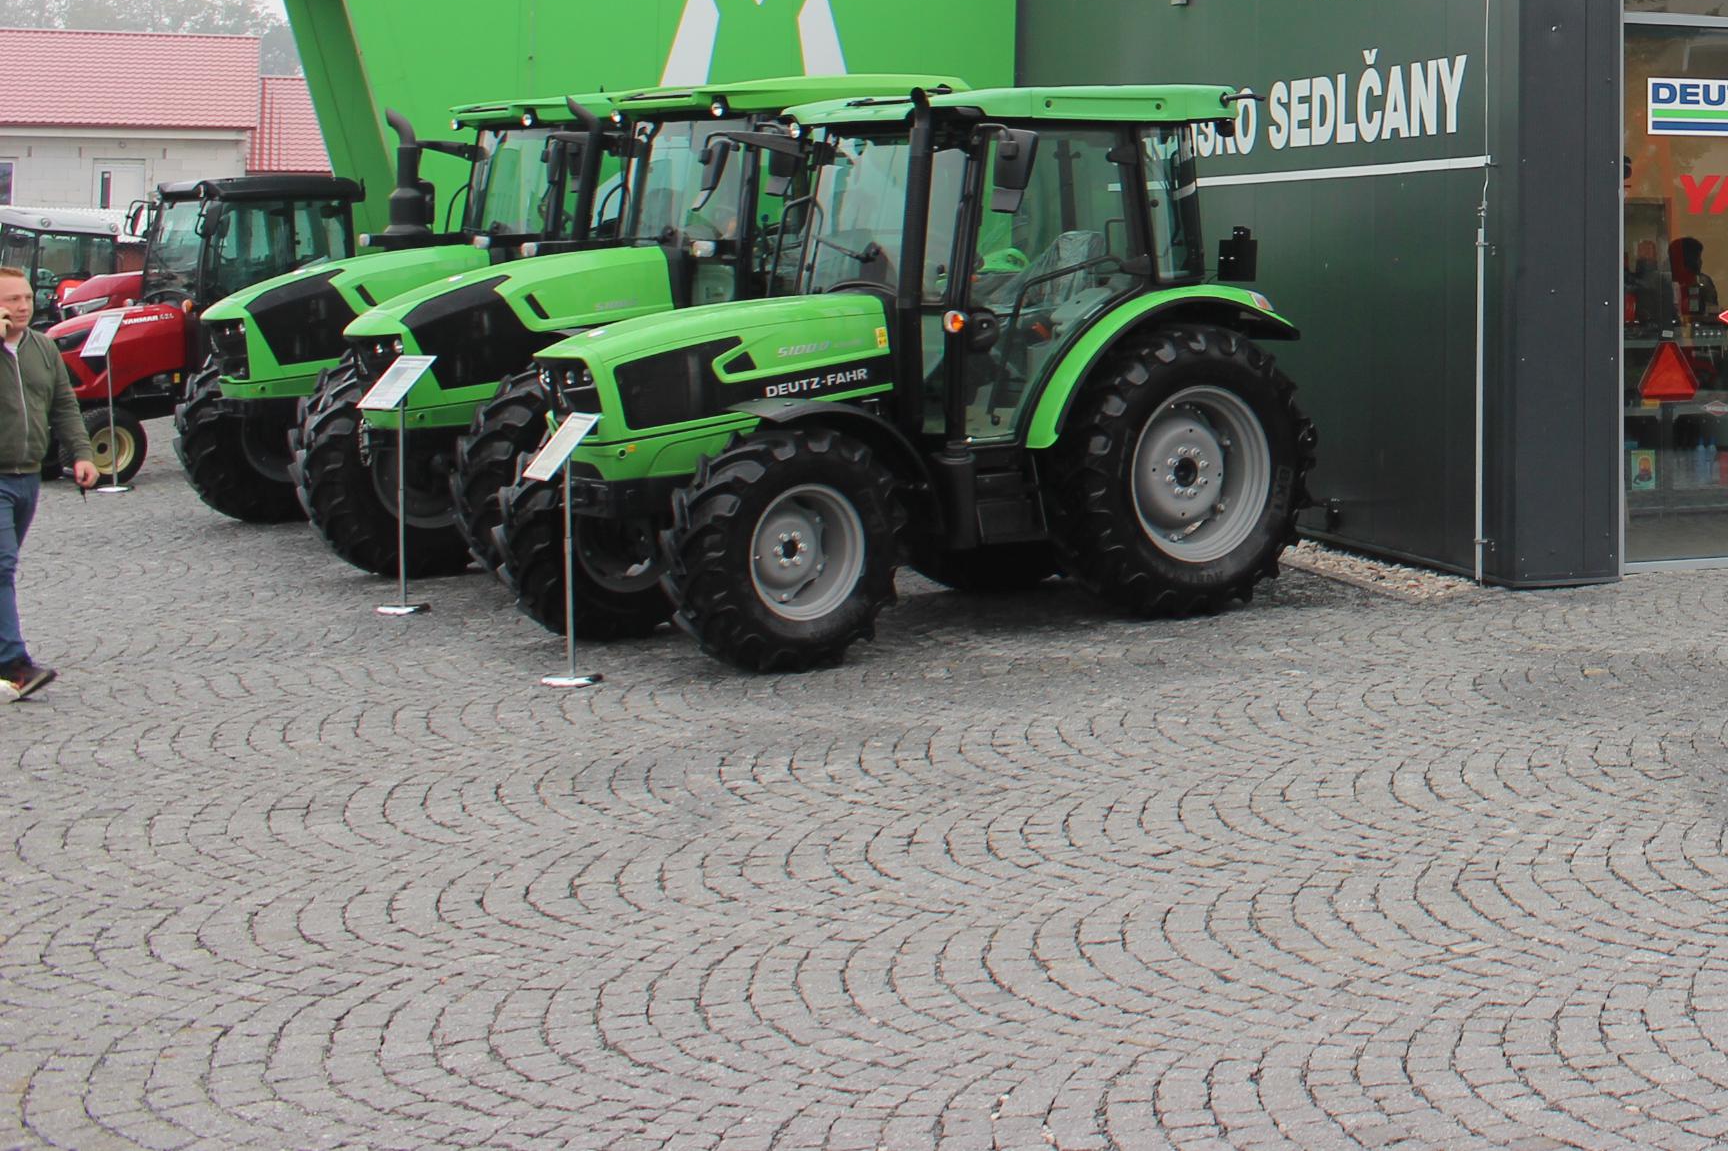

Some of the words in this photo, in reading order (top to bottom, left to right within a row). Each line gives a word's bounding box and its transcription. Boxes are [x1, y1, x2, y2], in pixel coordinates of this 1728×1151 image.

[1267, 48, 1468, 149] SEDLČANY
[123, 315, 158, 325] YANMAR
[766, 368, 868, 398] DEUTZ-FAHR
